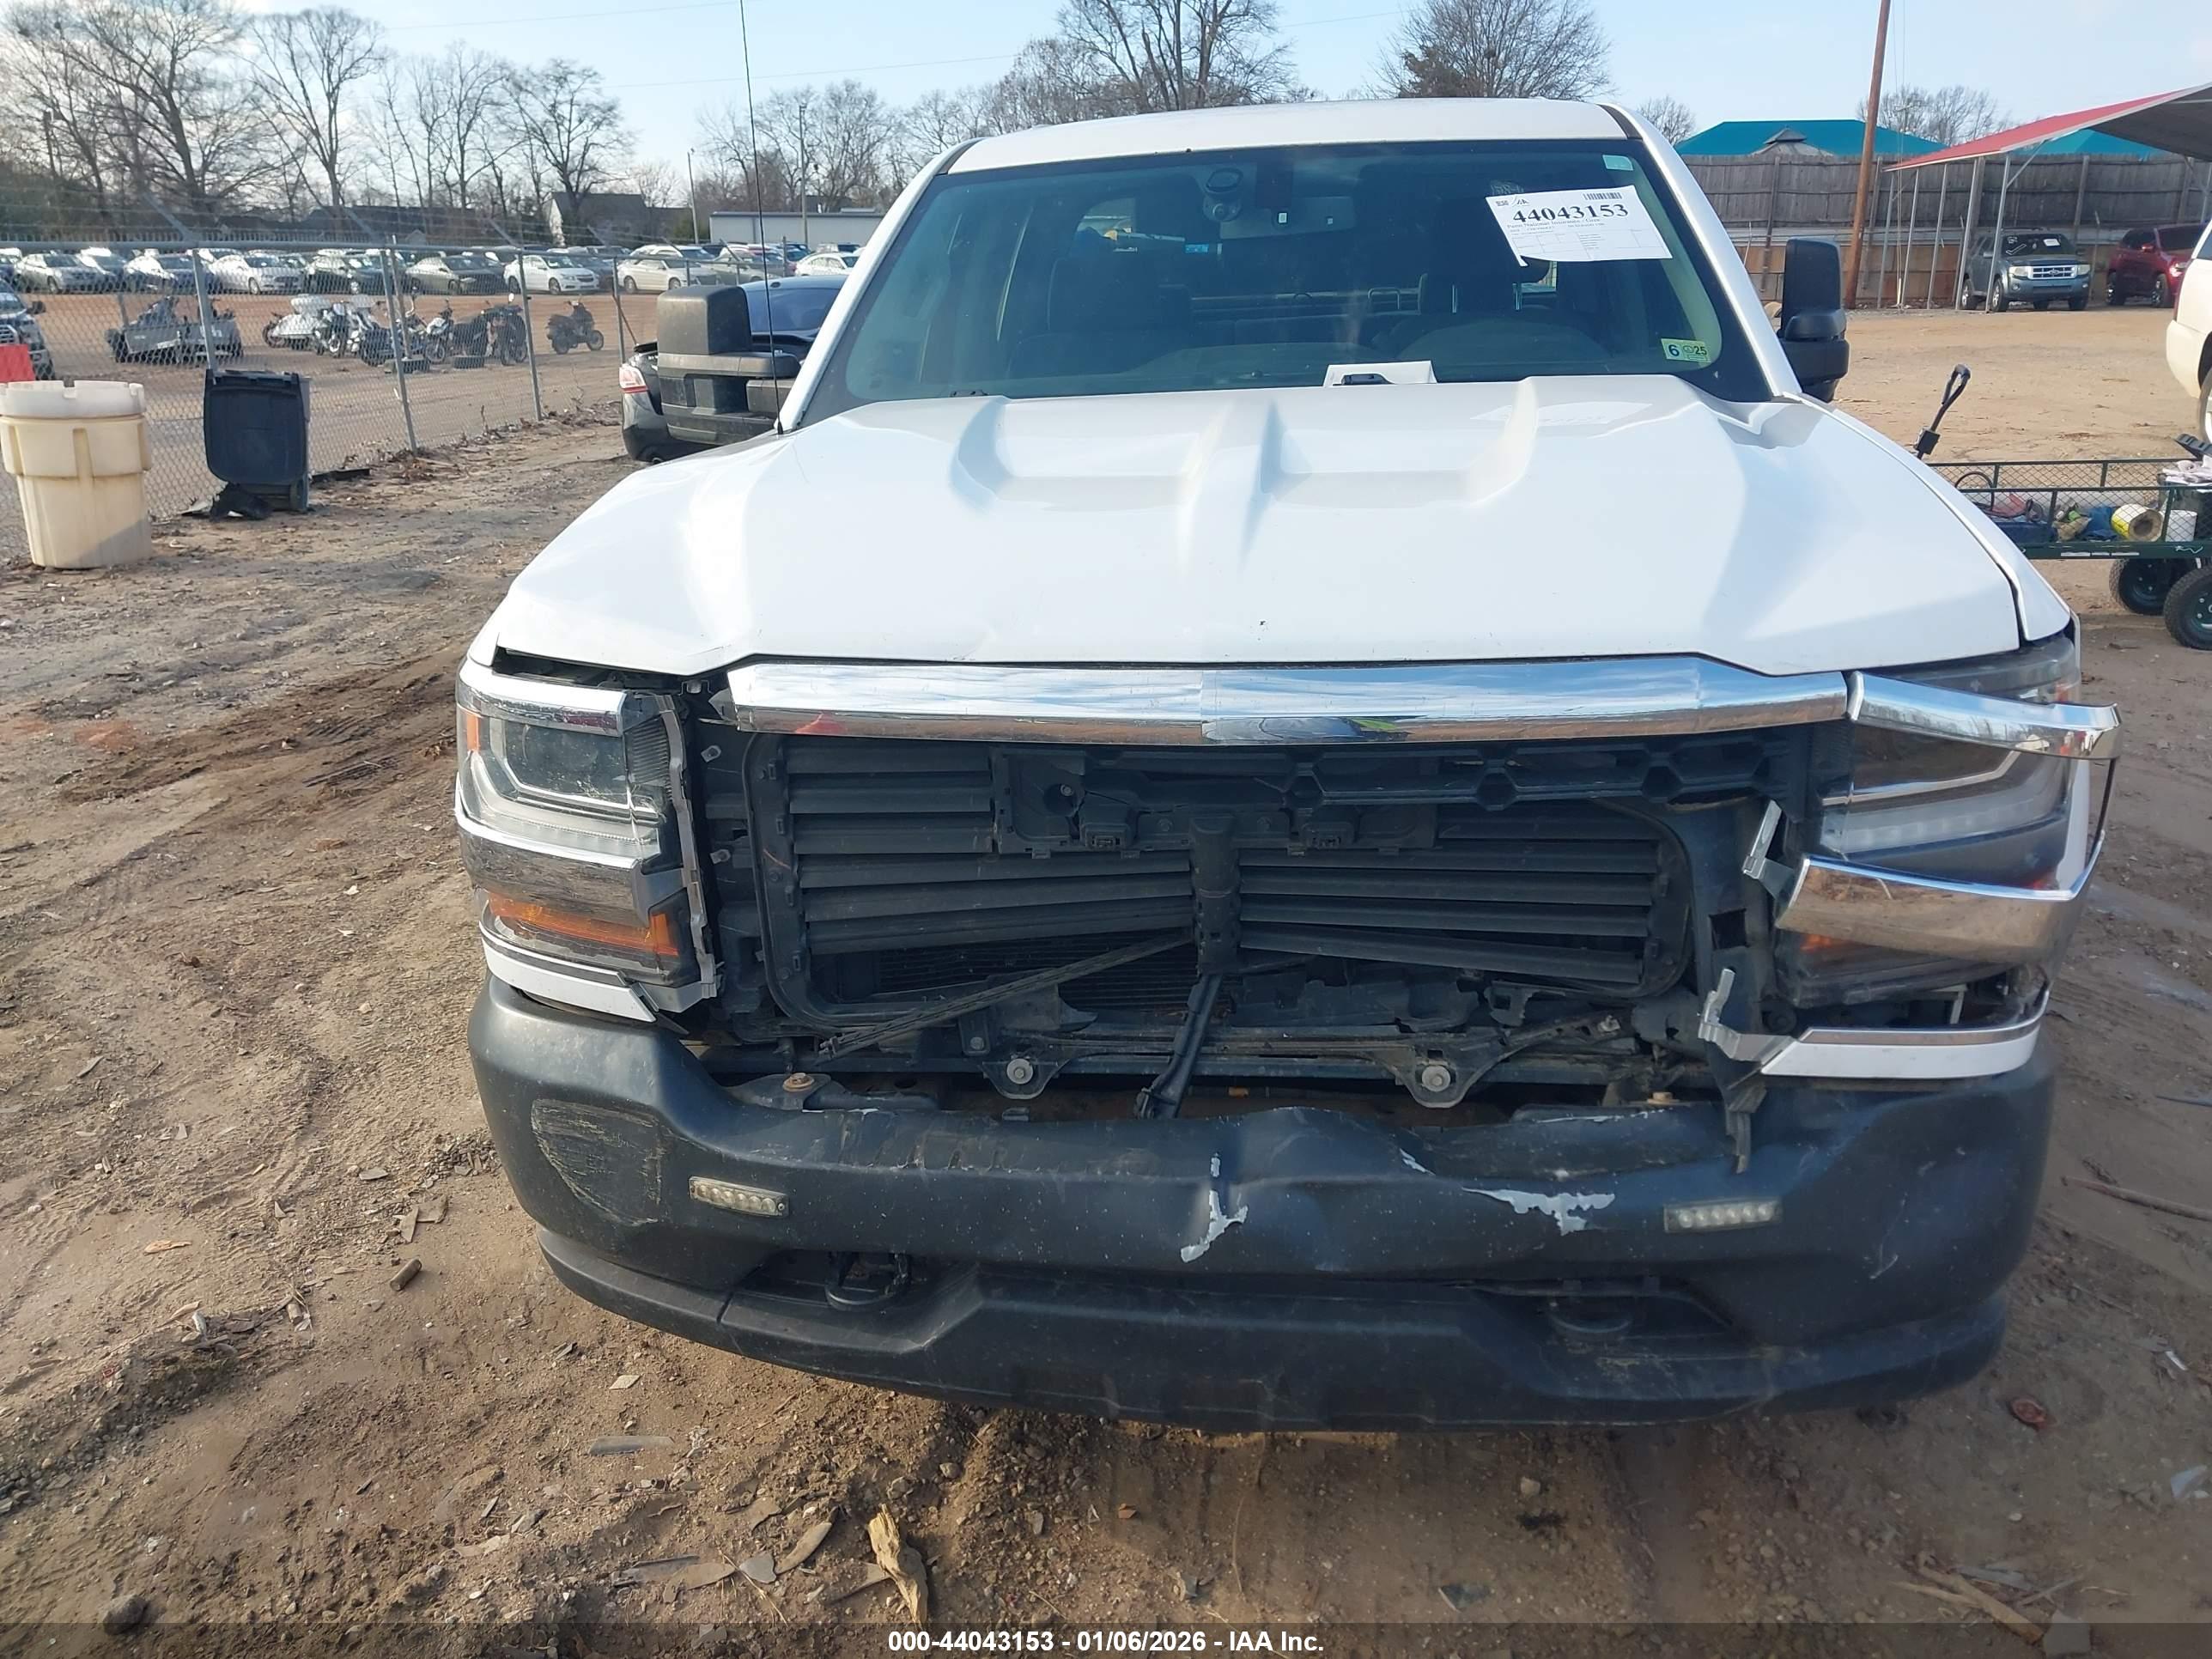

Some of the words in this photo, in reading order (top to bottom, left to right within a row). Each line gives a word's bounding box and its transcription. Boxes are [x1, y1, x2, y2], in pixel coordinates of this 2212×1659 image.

[1513, 204, 1629, 222] 44043153
[1668, 344, 1680, 356] 6
[1693, 345, 1707, 356] 25
